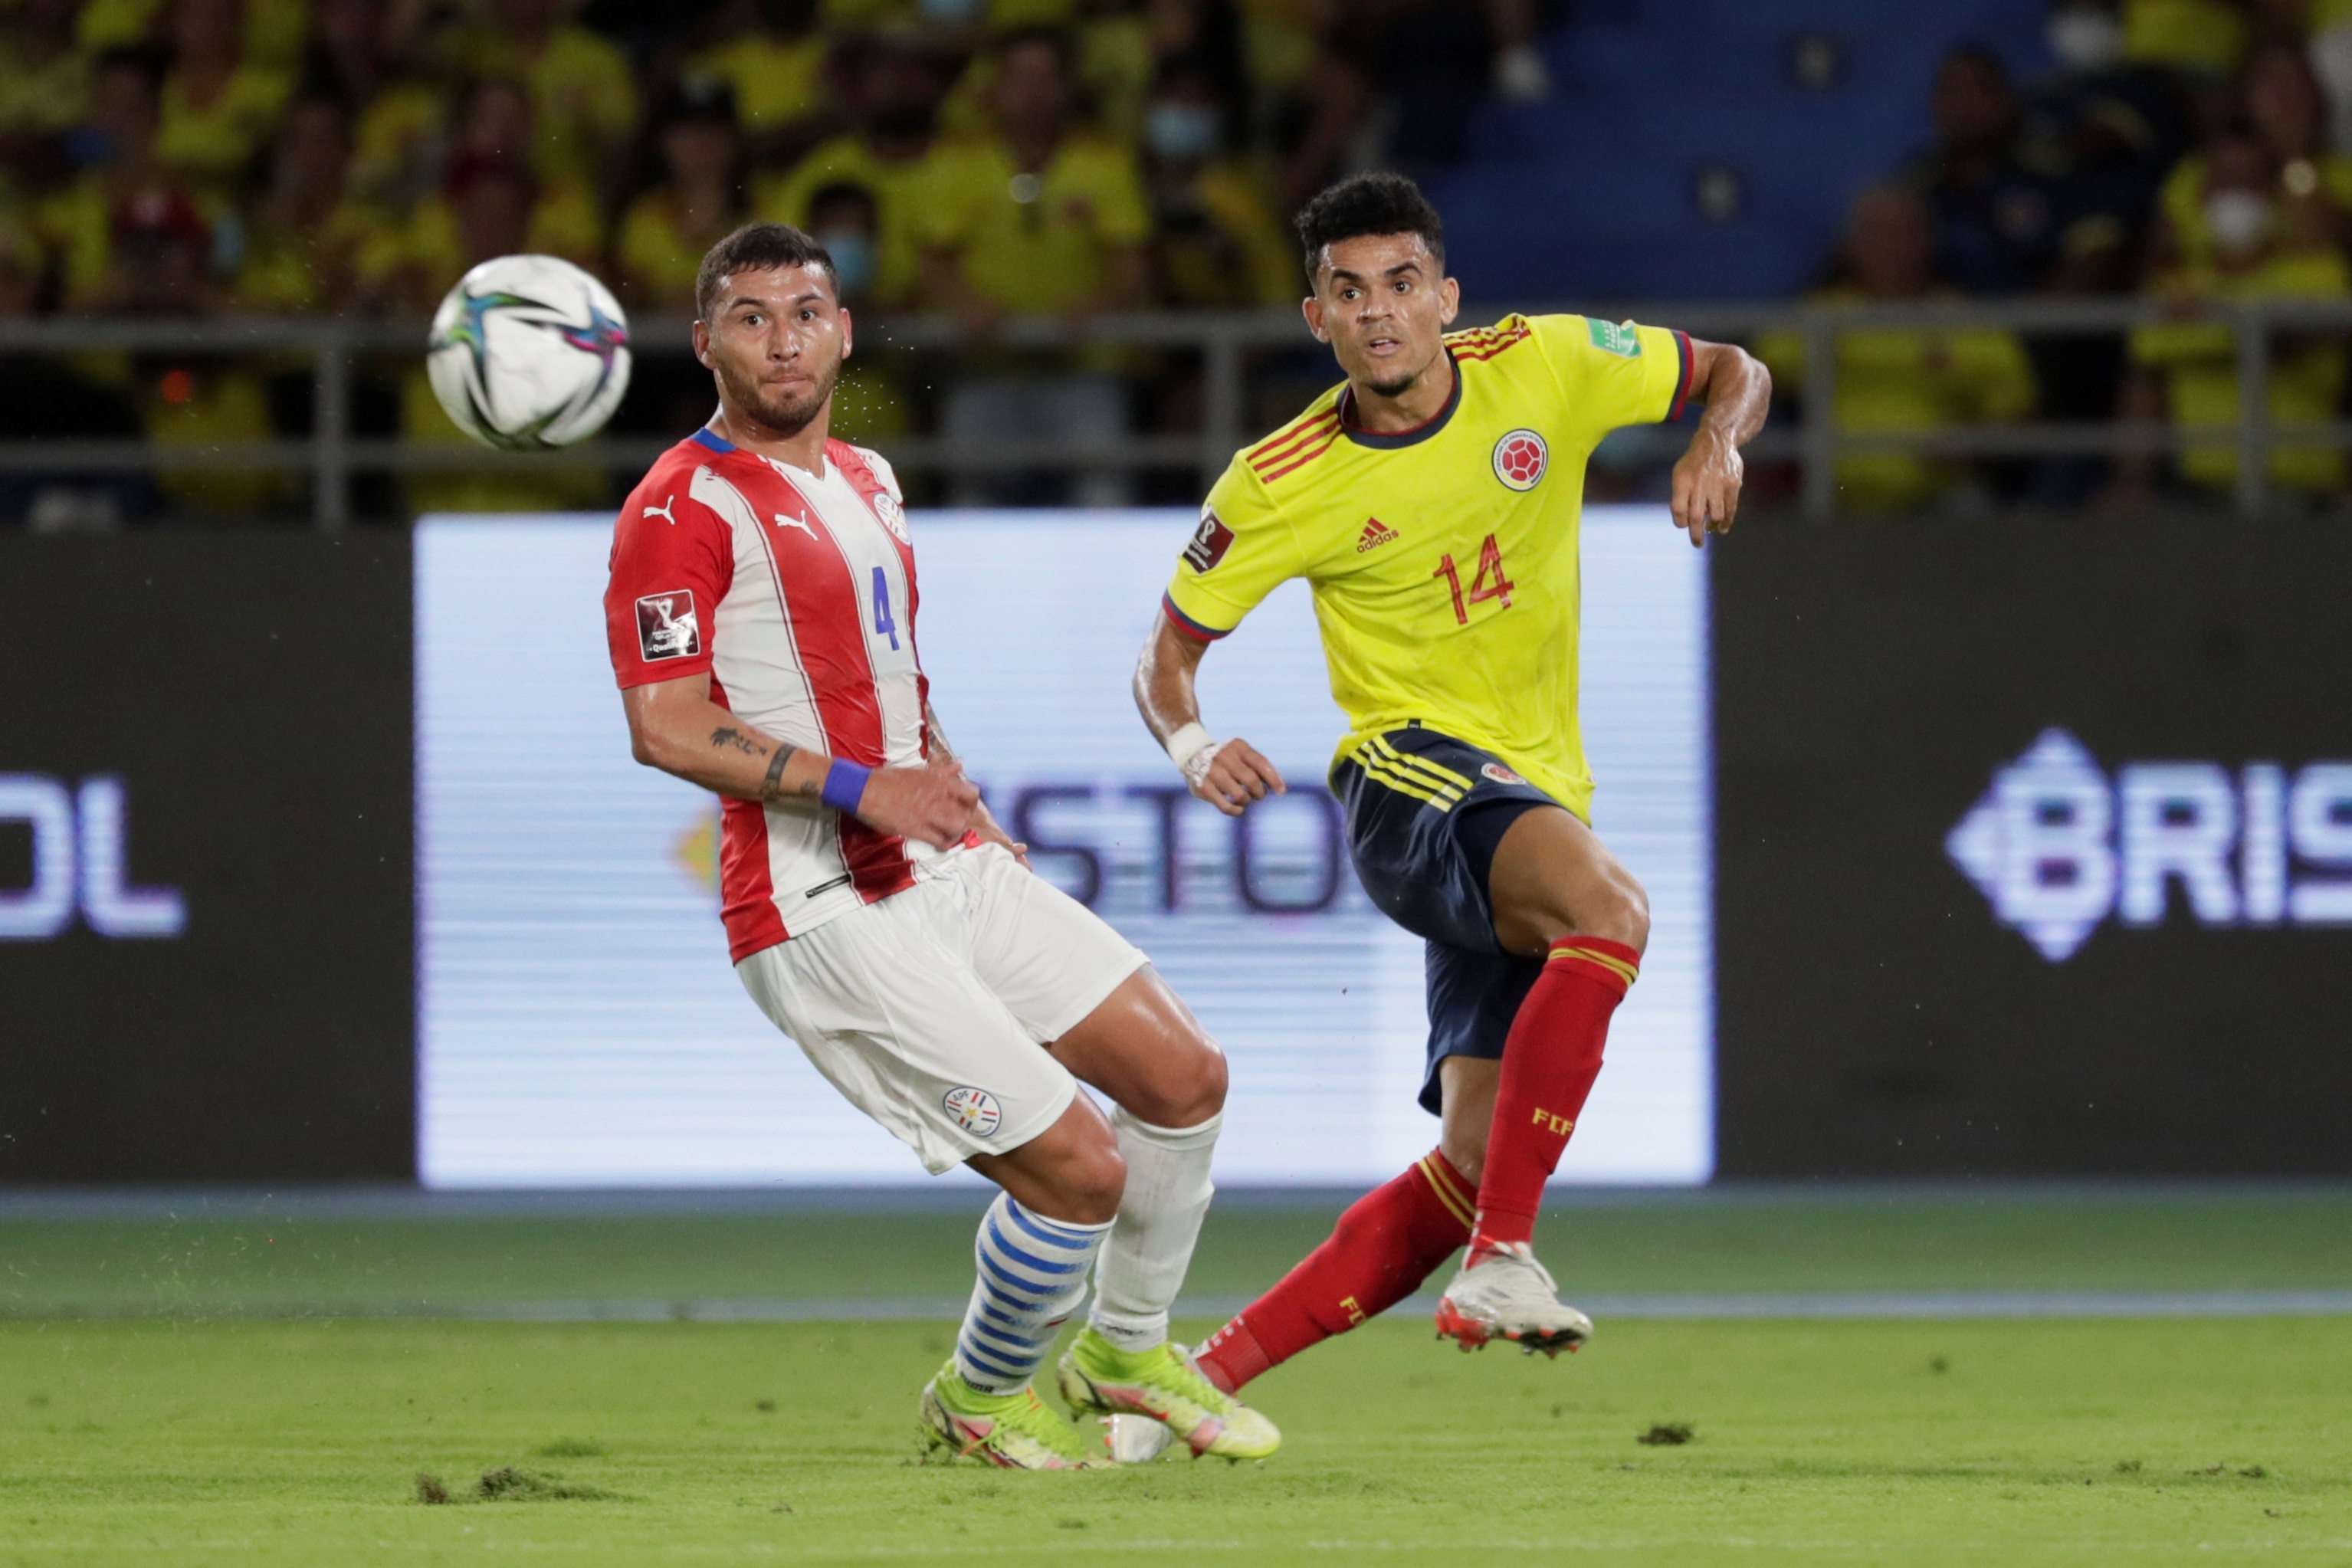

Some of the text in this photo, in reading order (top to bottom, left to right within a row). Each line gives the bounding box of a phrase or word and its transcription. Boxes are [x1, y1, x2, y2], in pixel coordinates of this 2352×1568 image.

[1356, 529, 1399, 553] adidas
[1432, 532, 1515, 625] 14
[872, 566, 900, 652] 4
[953, 1090, 969, 1102] APF
